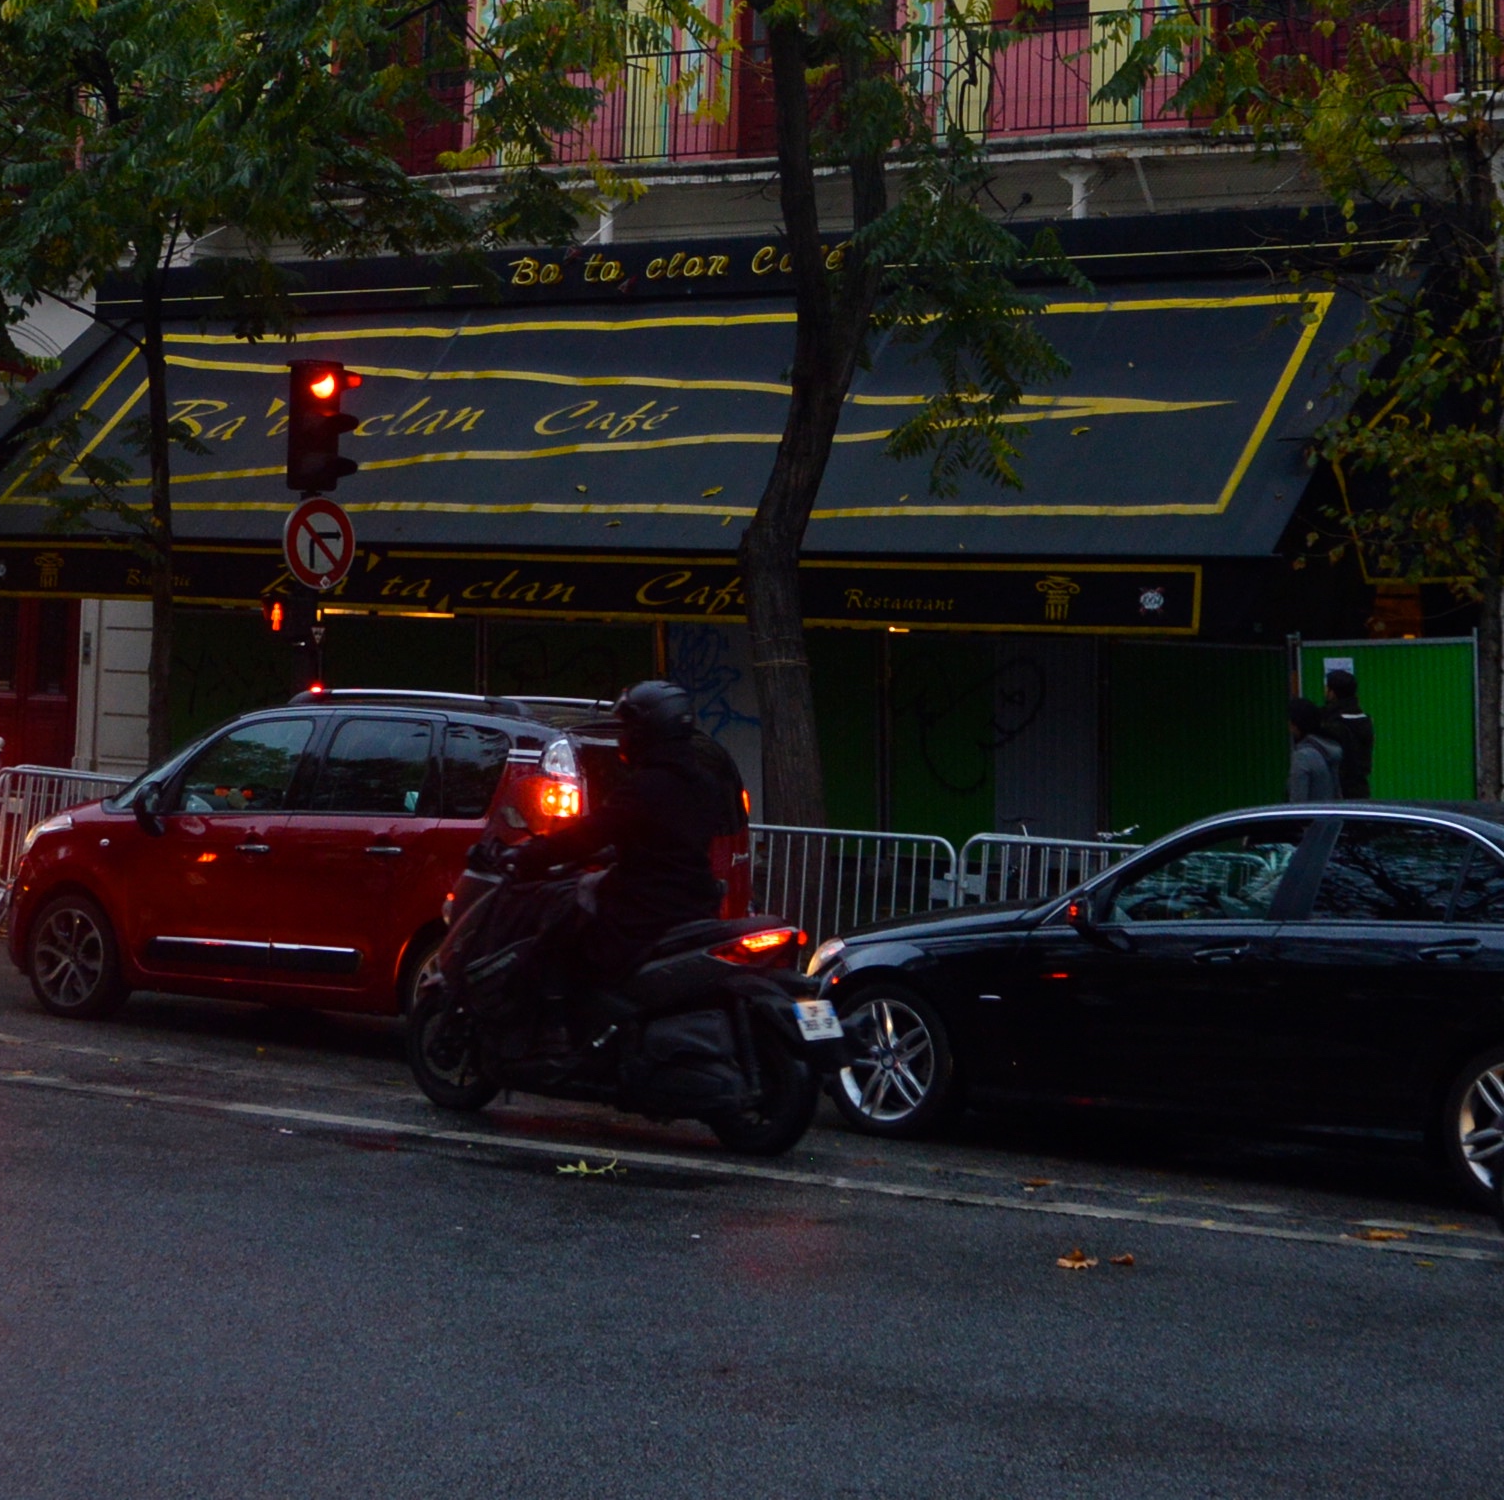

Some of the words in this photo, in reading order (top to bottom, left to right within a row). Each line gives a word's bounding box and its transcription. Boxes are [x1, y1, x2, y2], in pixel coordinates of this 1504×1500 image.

[508, 256, 562, 286] Ba
[583, 252, 623, 282] ta
[646, 252, 730, 280] clan
[752, 241, 851, 275] Caé
[353, 396, 486, 437] clan
[534, 399, 680, 440] Café
[381, 576, 432, 597] ta
[462, 569, 576, 603] clan
[845, 588, 955, 611] Restaurant
